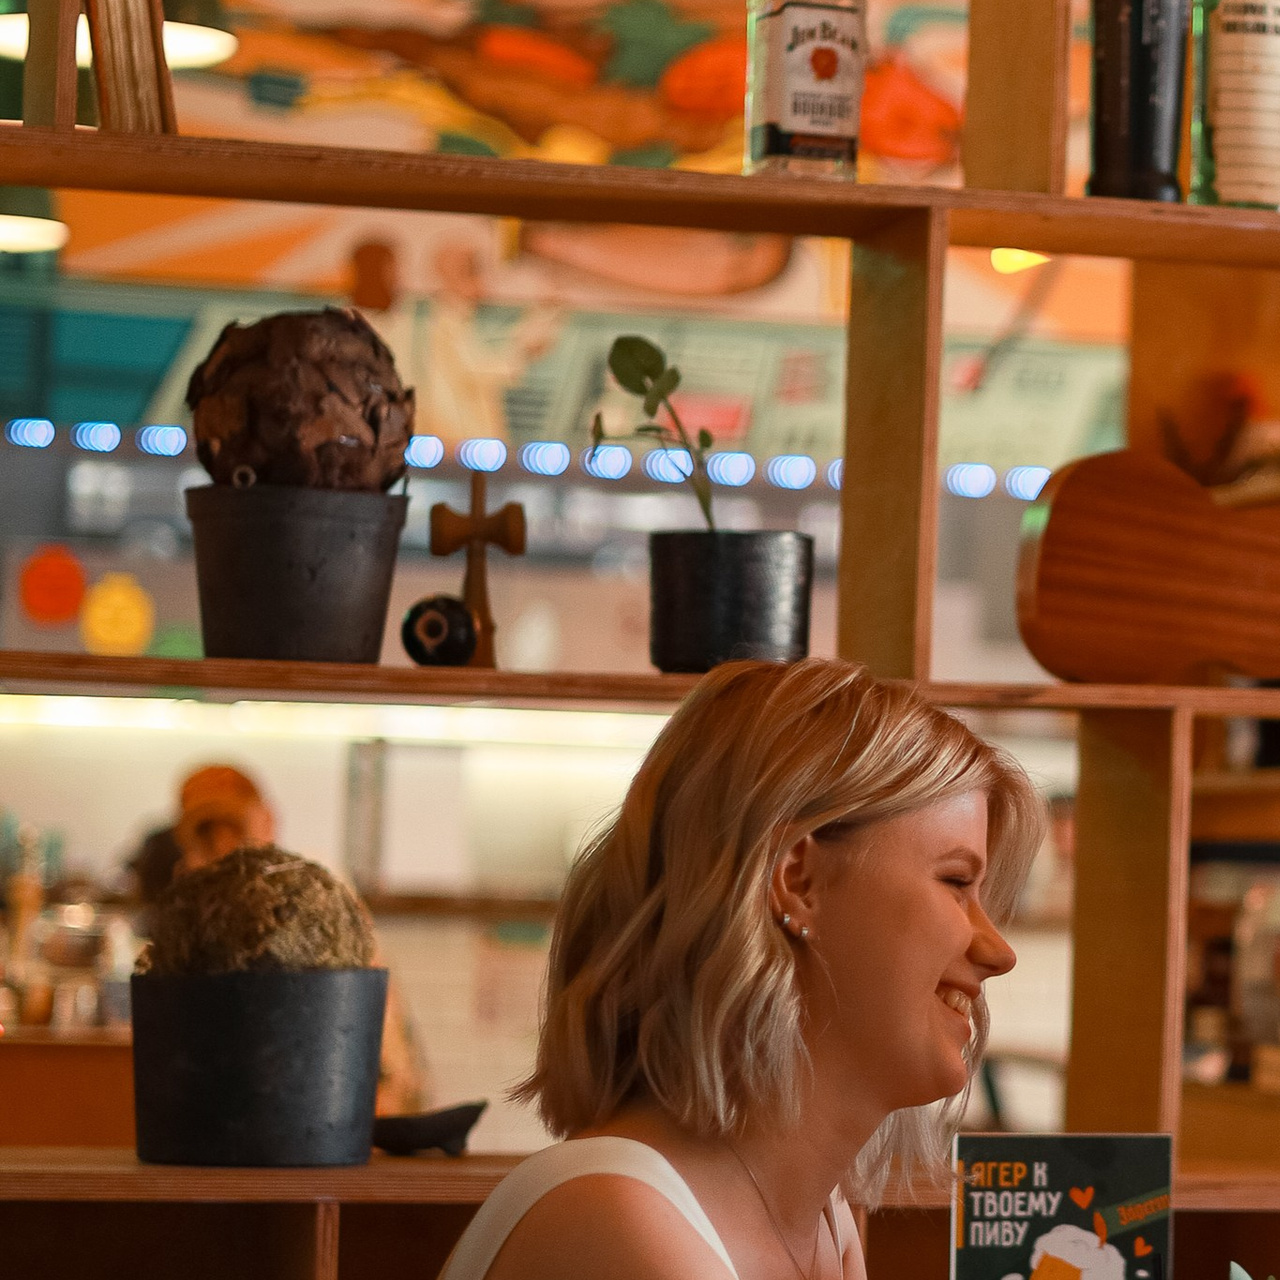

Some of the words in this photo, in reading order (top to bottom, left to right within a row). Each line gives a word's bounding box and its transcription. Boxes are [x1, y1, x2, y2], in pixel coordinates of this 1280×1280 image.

[971, 1161, 1028, 1188] ЯГЕР
[1033, 1161, 1048, 1187] К
[969, 1191, 1063, 1218] ТВОЕМУ
[969, 1221, 1030, 1247] ПИВУ
